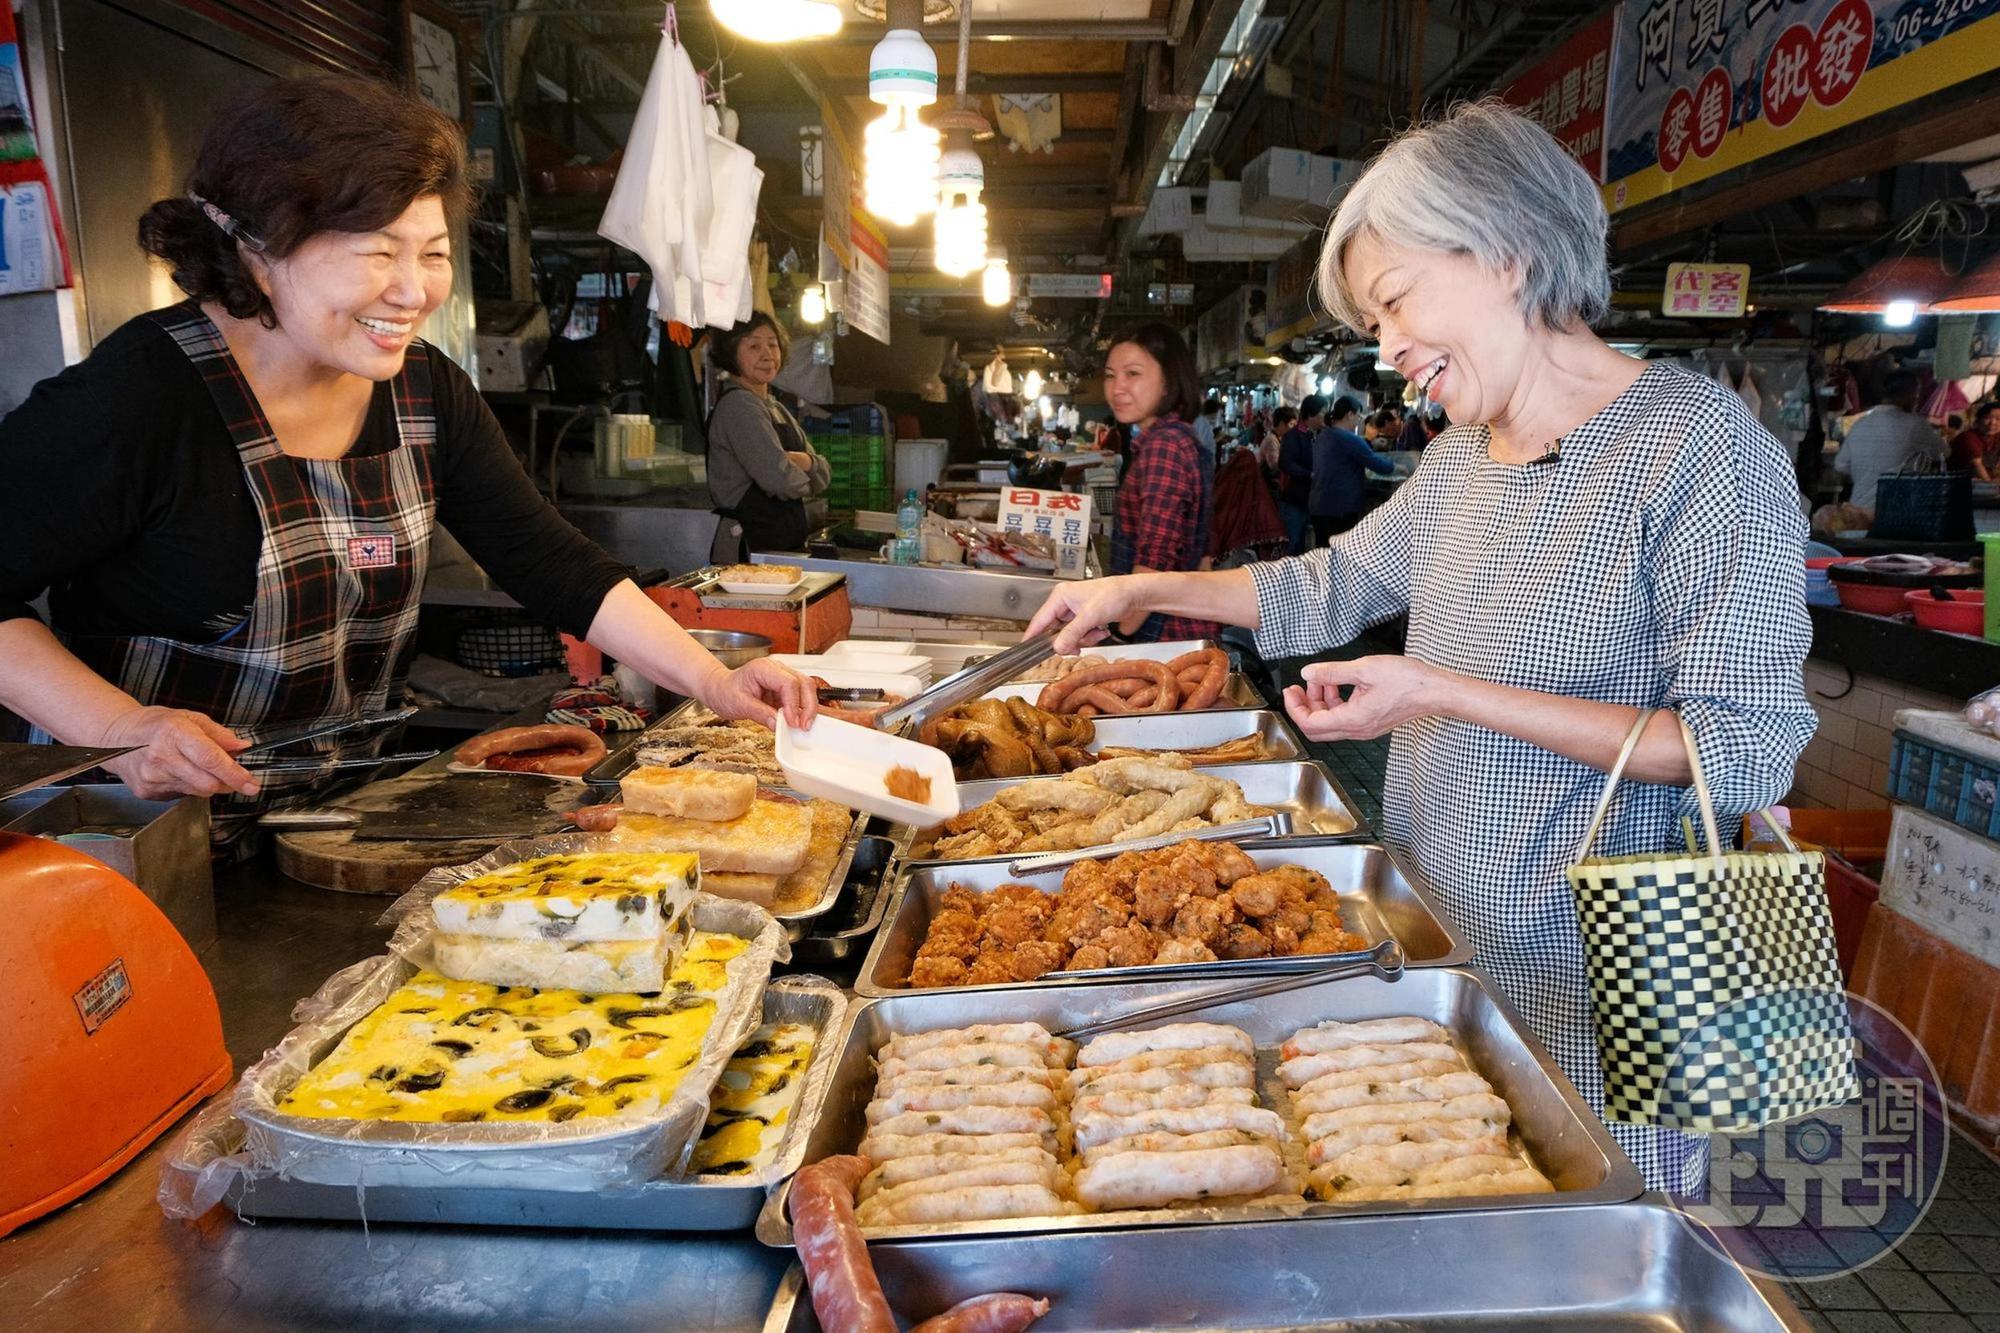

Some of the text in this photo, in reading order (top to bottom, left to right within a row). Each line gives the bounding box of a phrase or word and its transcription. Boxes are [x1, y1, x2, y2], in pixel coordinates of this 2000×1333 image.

[1894, 0, 1986, 44] 06-22
[1664, 80, 1724, 162] 零售
[1766, 8, 1867, 113] 批發
[1673, 271, 1742, 291] 代客
[1009, 490, 1082, 511] 日式
[1062, 518, 1081, 545] 豆花
